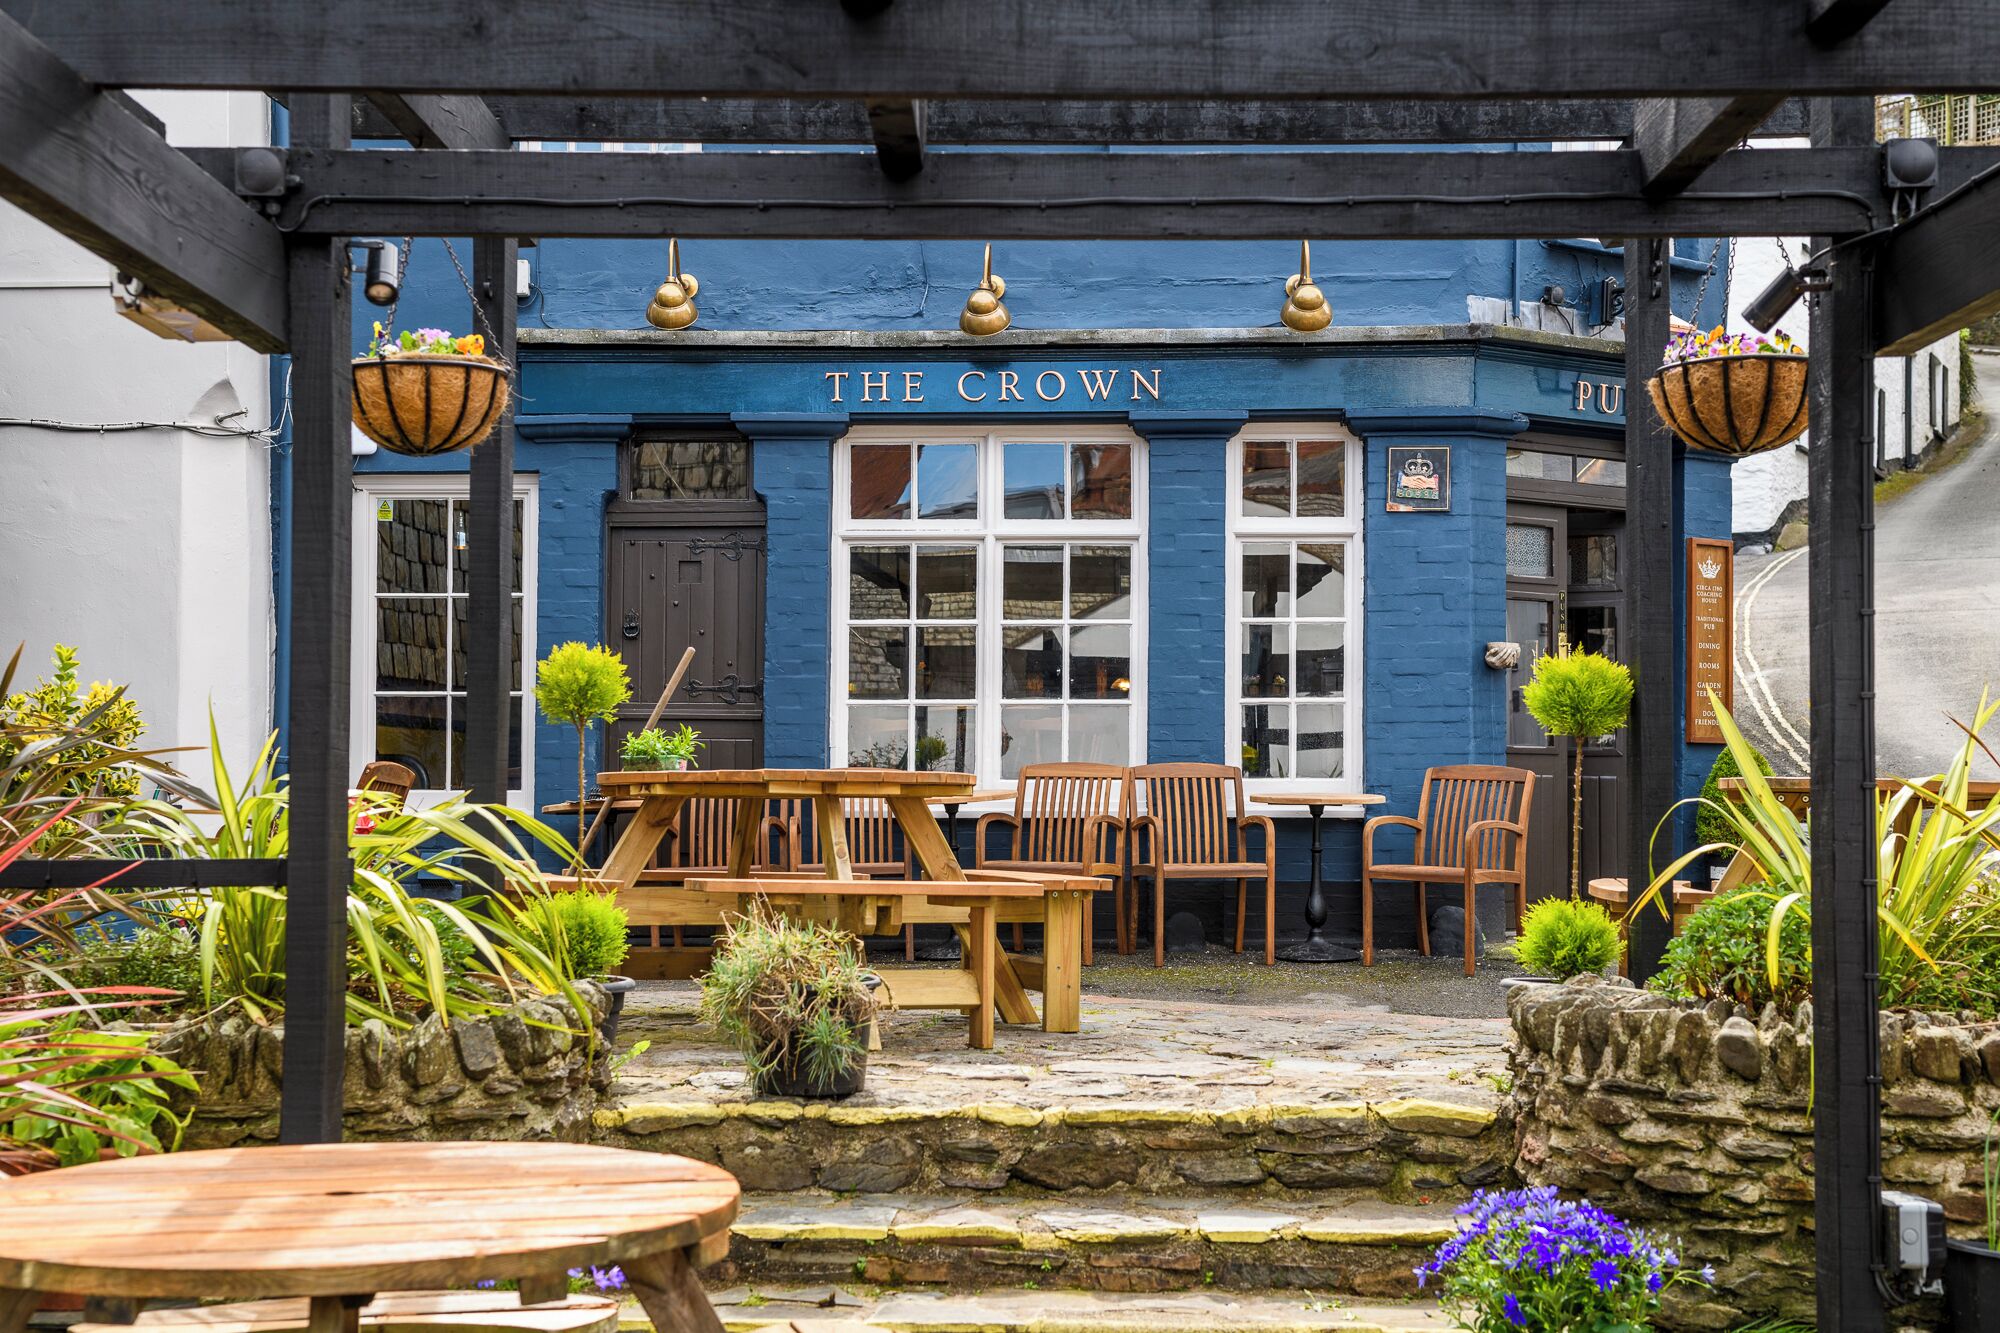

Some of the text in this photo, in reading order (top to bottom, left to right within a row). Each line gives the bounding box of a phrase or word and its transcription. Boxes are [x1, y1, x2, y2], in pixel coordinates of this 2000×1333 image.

[825, 369, 1162, 402] THE CROWN
[1577, 380, 1622, 414] PU
[1698, 642, 1720, 650] DINING
[1698, 662, 1720, 670] ROOMS
[1695, 718, 1719, 726] FRIENDL
